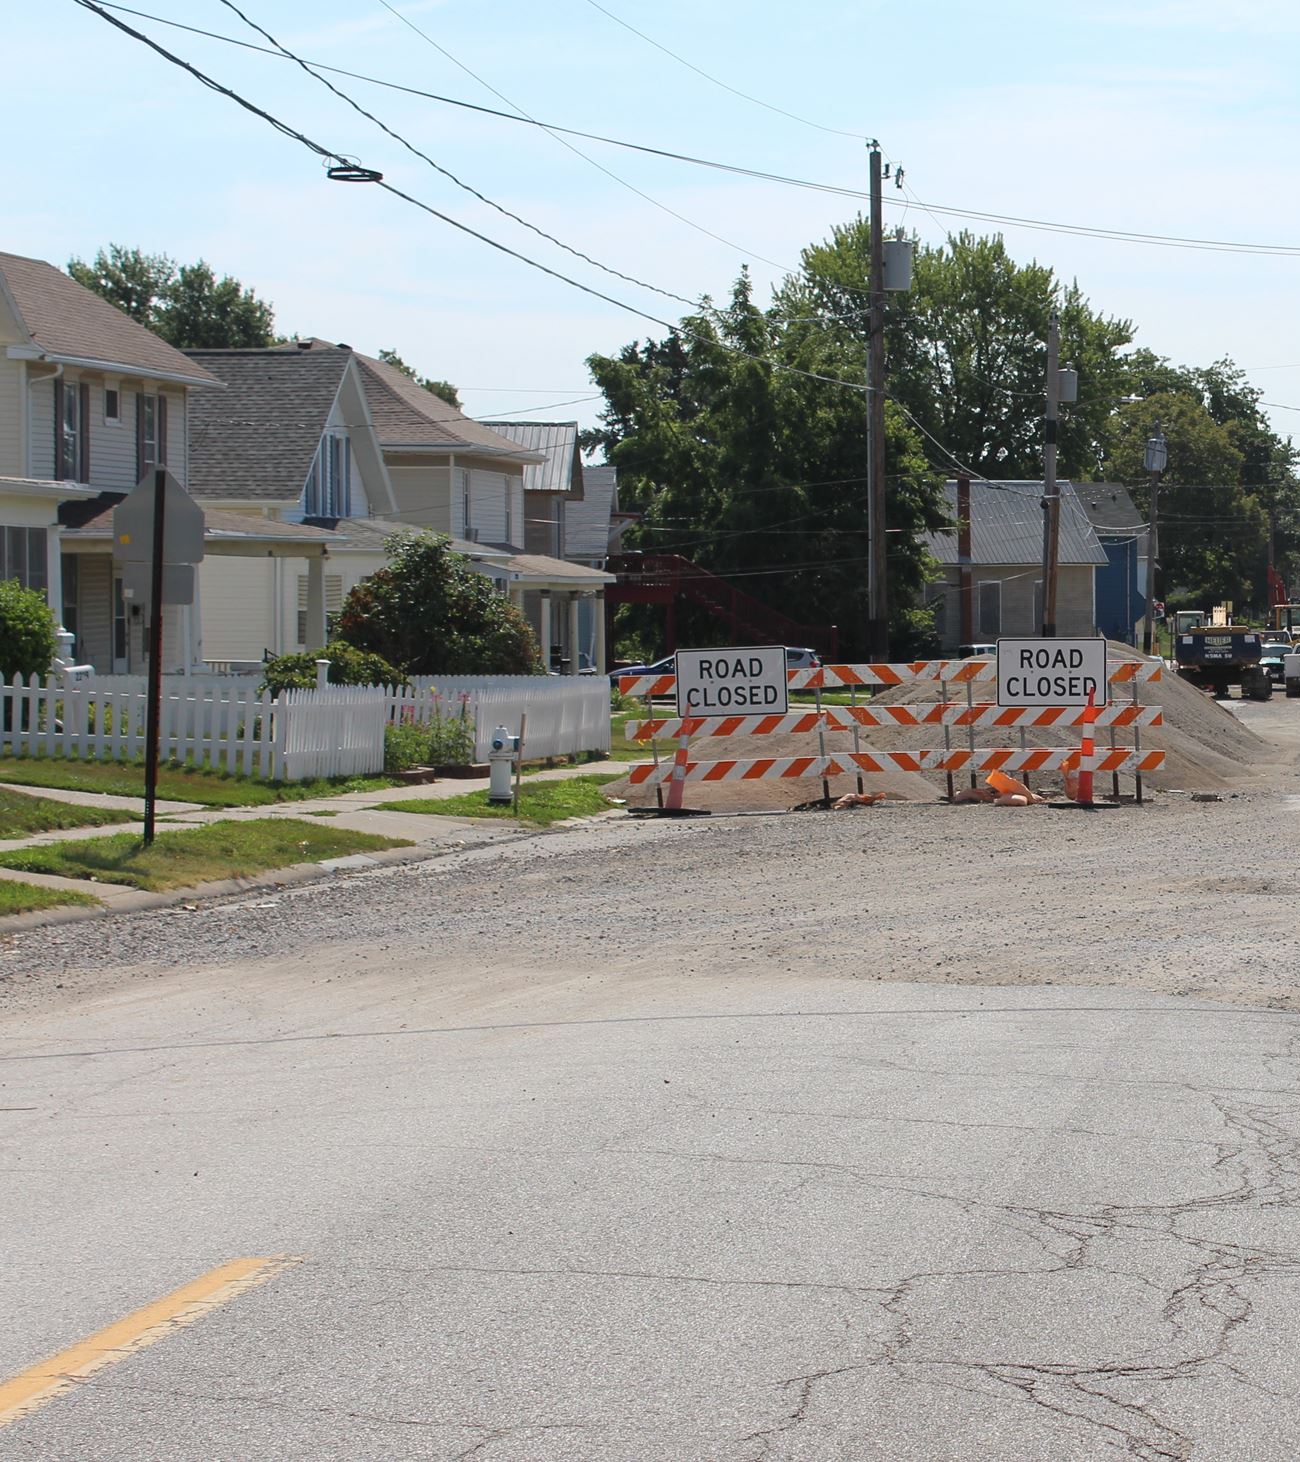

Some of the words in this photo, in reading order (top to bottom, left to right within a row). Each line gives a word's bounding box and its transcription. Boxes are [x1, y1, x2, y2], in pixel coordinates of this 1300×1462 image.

[699, 658, 763, 679] ROAD
[1020, 648, 1083, 669] ROAD
[686, 685, 778, 707] CLOSED
[1006, 676, 1097, 697] CLOSED
